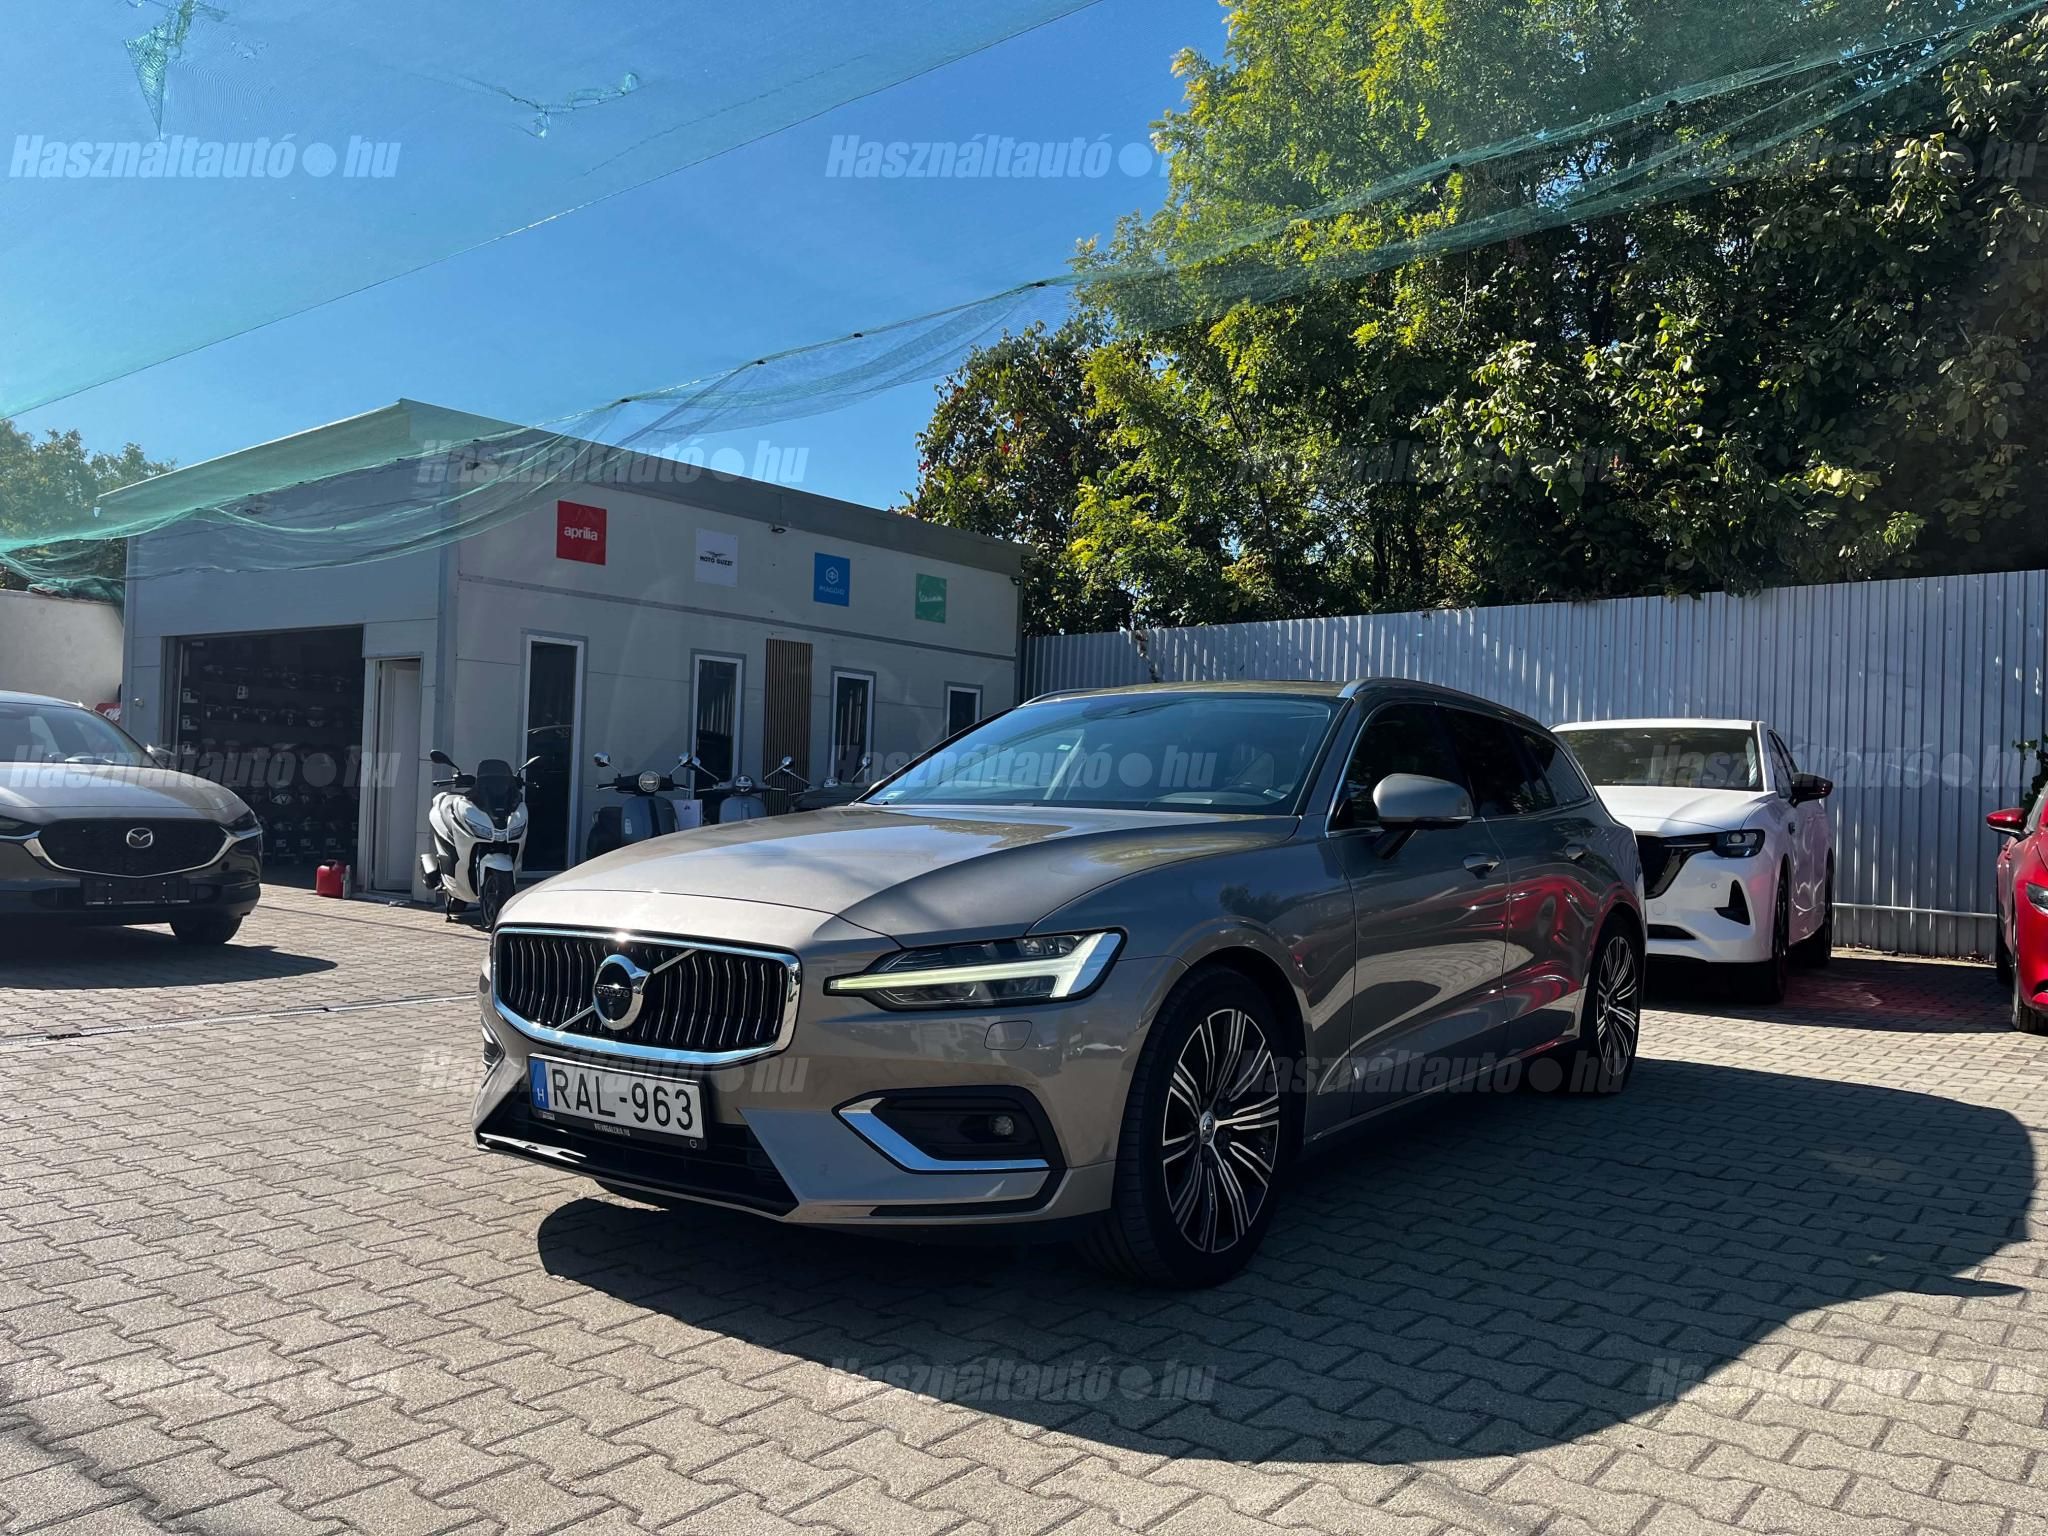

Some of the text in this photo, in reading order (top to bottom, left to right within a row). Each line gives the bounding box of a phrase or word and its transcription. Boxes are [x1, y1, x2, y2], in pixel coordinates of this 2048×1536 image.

[563, 525, 598, 542] aprilia
[699, 555, 734, 567] MOTO GUZZI
[536, 1068, 694, 1131] H RAL-963
